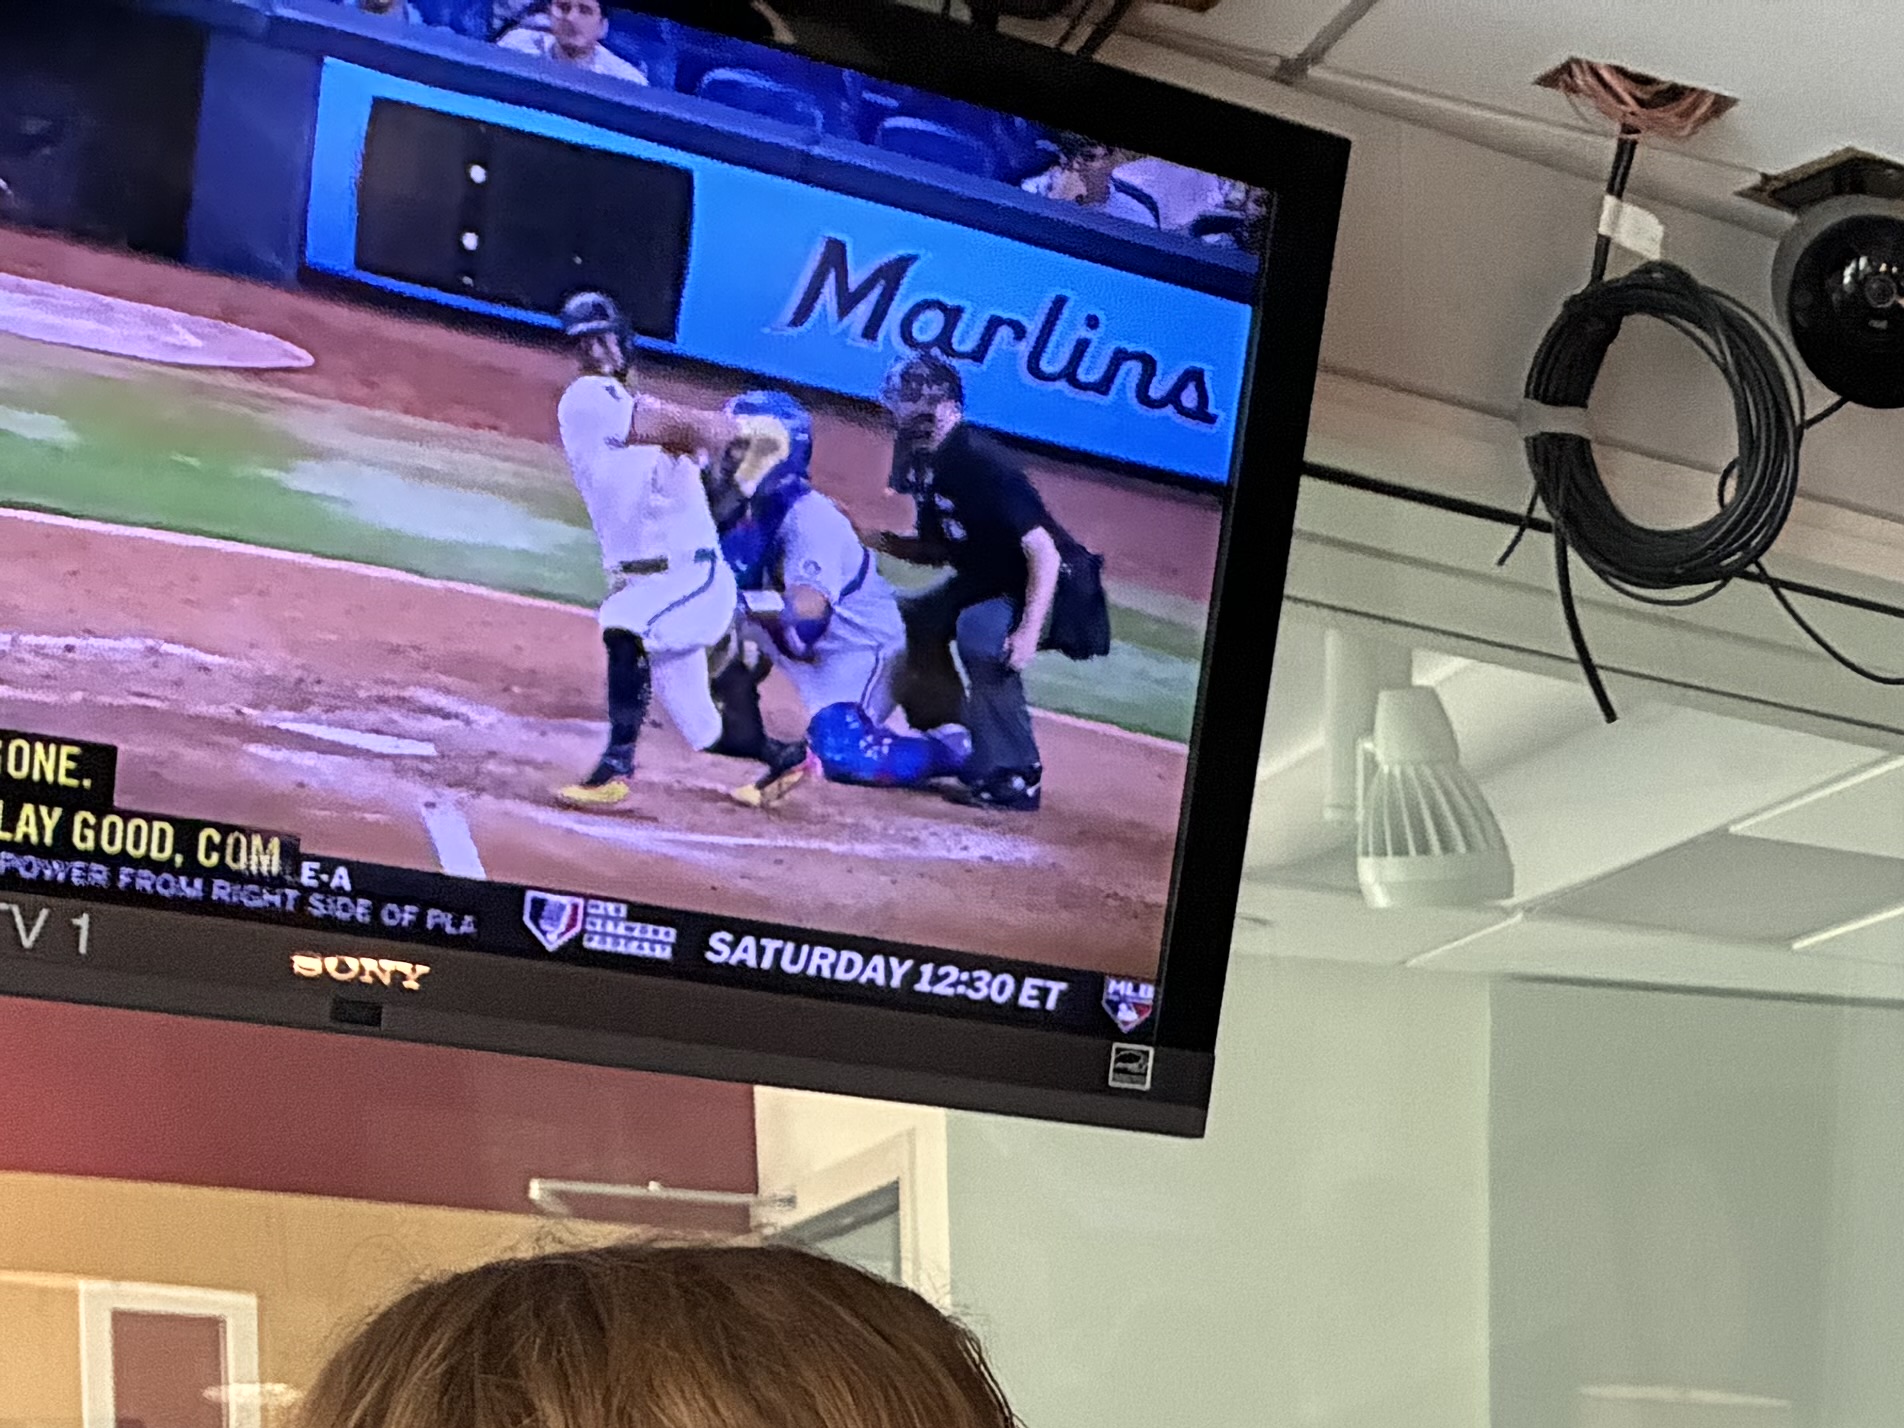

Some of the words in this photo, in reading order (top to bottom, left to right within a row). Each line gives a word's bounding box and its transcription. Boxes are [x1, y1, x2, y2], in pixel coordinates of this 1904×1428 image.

[783, 233, 1219, 426] Marlins
[0, 737, 92, 789] ONE.
[71, 809, 184, 868] GOOD,
[0, 851, 110, 888] POWER
[117, 864, 204, 901] FROM
[211, 877, 301, 912] RIGHT
[307, 892, 373, 924] SIDE
[380, 902, 419, 927] OF
[71, 911, 90, 955] 1
[290, 953, 432, 990] SONY
[703, 929, 914, 989] SATURDAY
[913, 961, 1016, 1004] 12:30
[1016, 976, 1069, 1012] ET
[1106, 979, 1155, 1000] MLB
